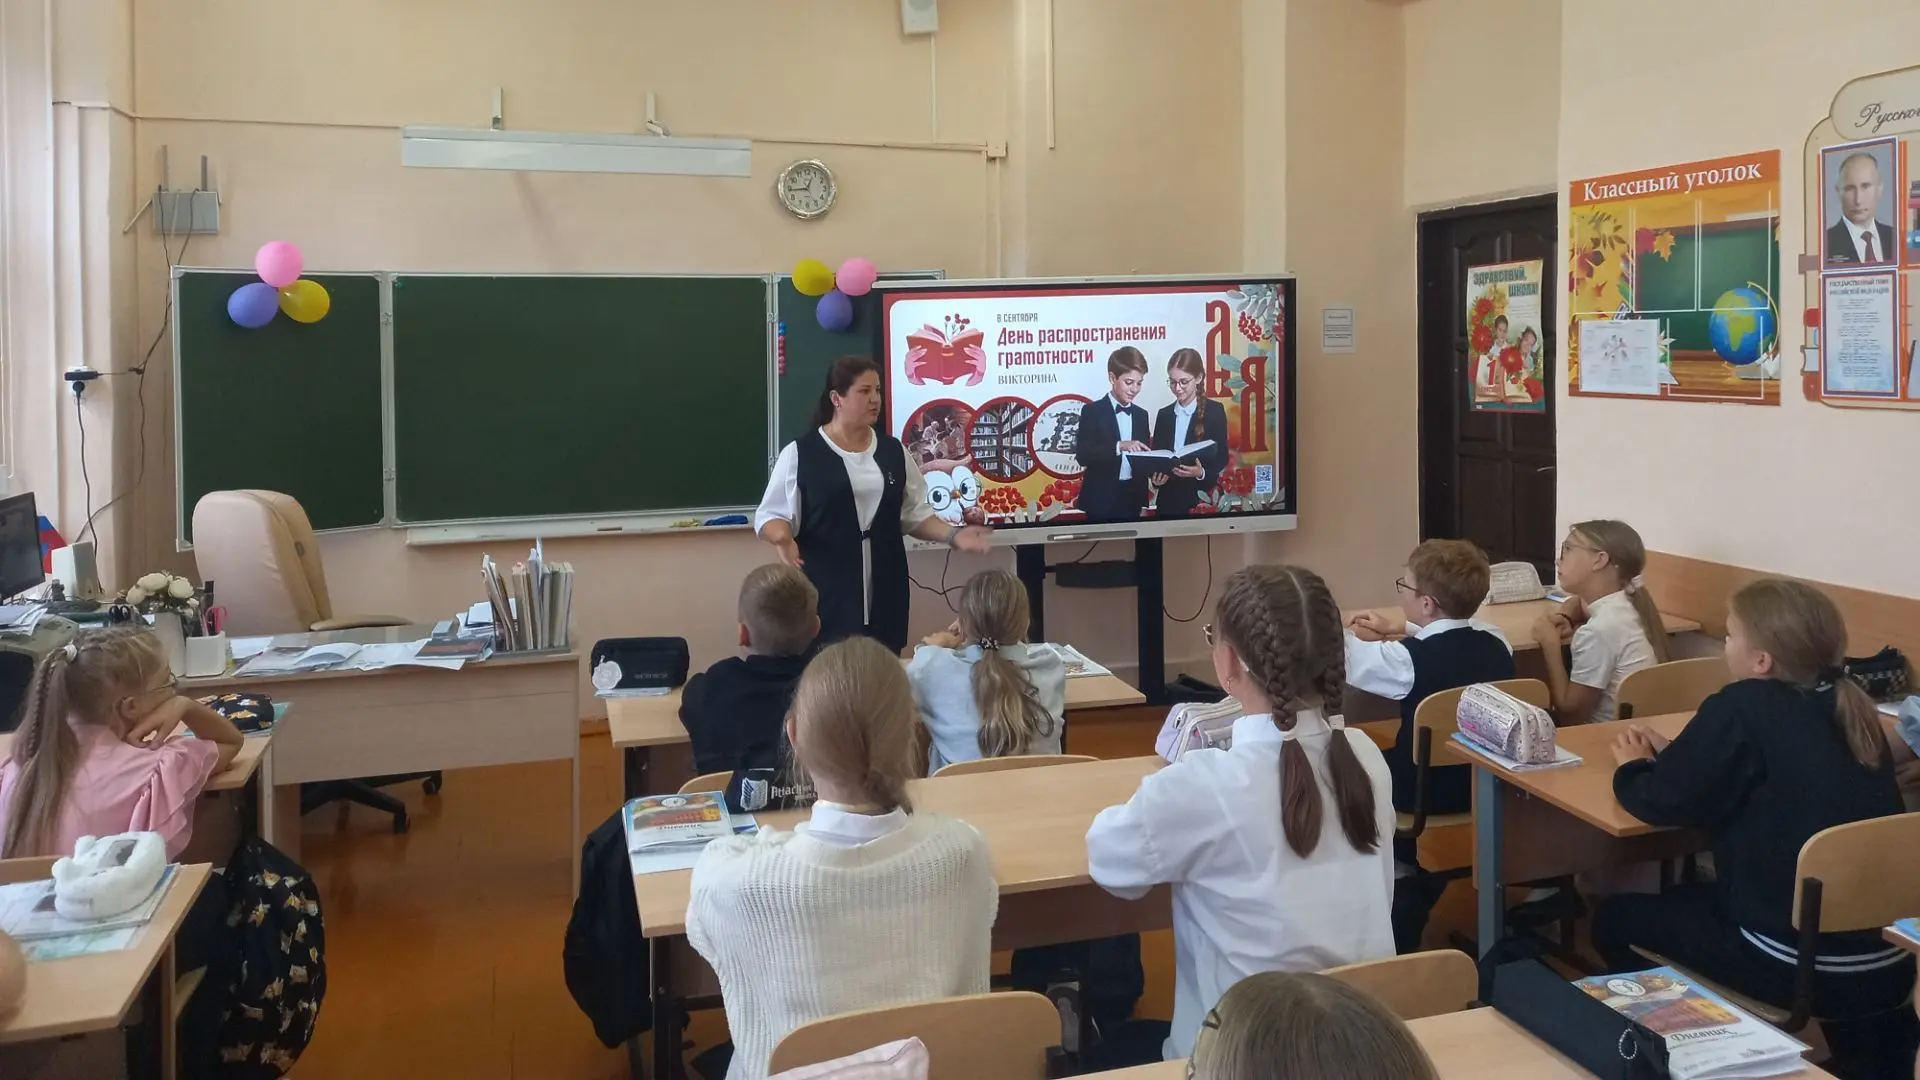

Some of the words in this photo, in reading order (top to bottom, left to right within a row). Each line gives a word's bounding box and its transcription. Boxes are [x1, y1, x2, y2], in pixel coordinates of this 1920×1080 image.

[1584, 171, 1679, 201] Классный
[1684, 163, 1762, 194] уголок
[1003, 312, 1038, 323] СЕНТЯБРЯ
[997, 327, 1033, 346] День
[1038, 325, 1166, 346] распространения
[998, 349, 1093, 369] грамотности
[998, 373, 1058, 385] ВИКТОРИНА
[1240, 355, 1268, 452] Я
[1671, 1027, 1738, 1042] Дневник
